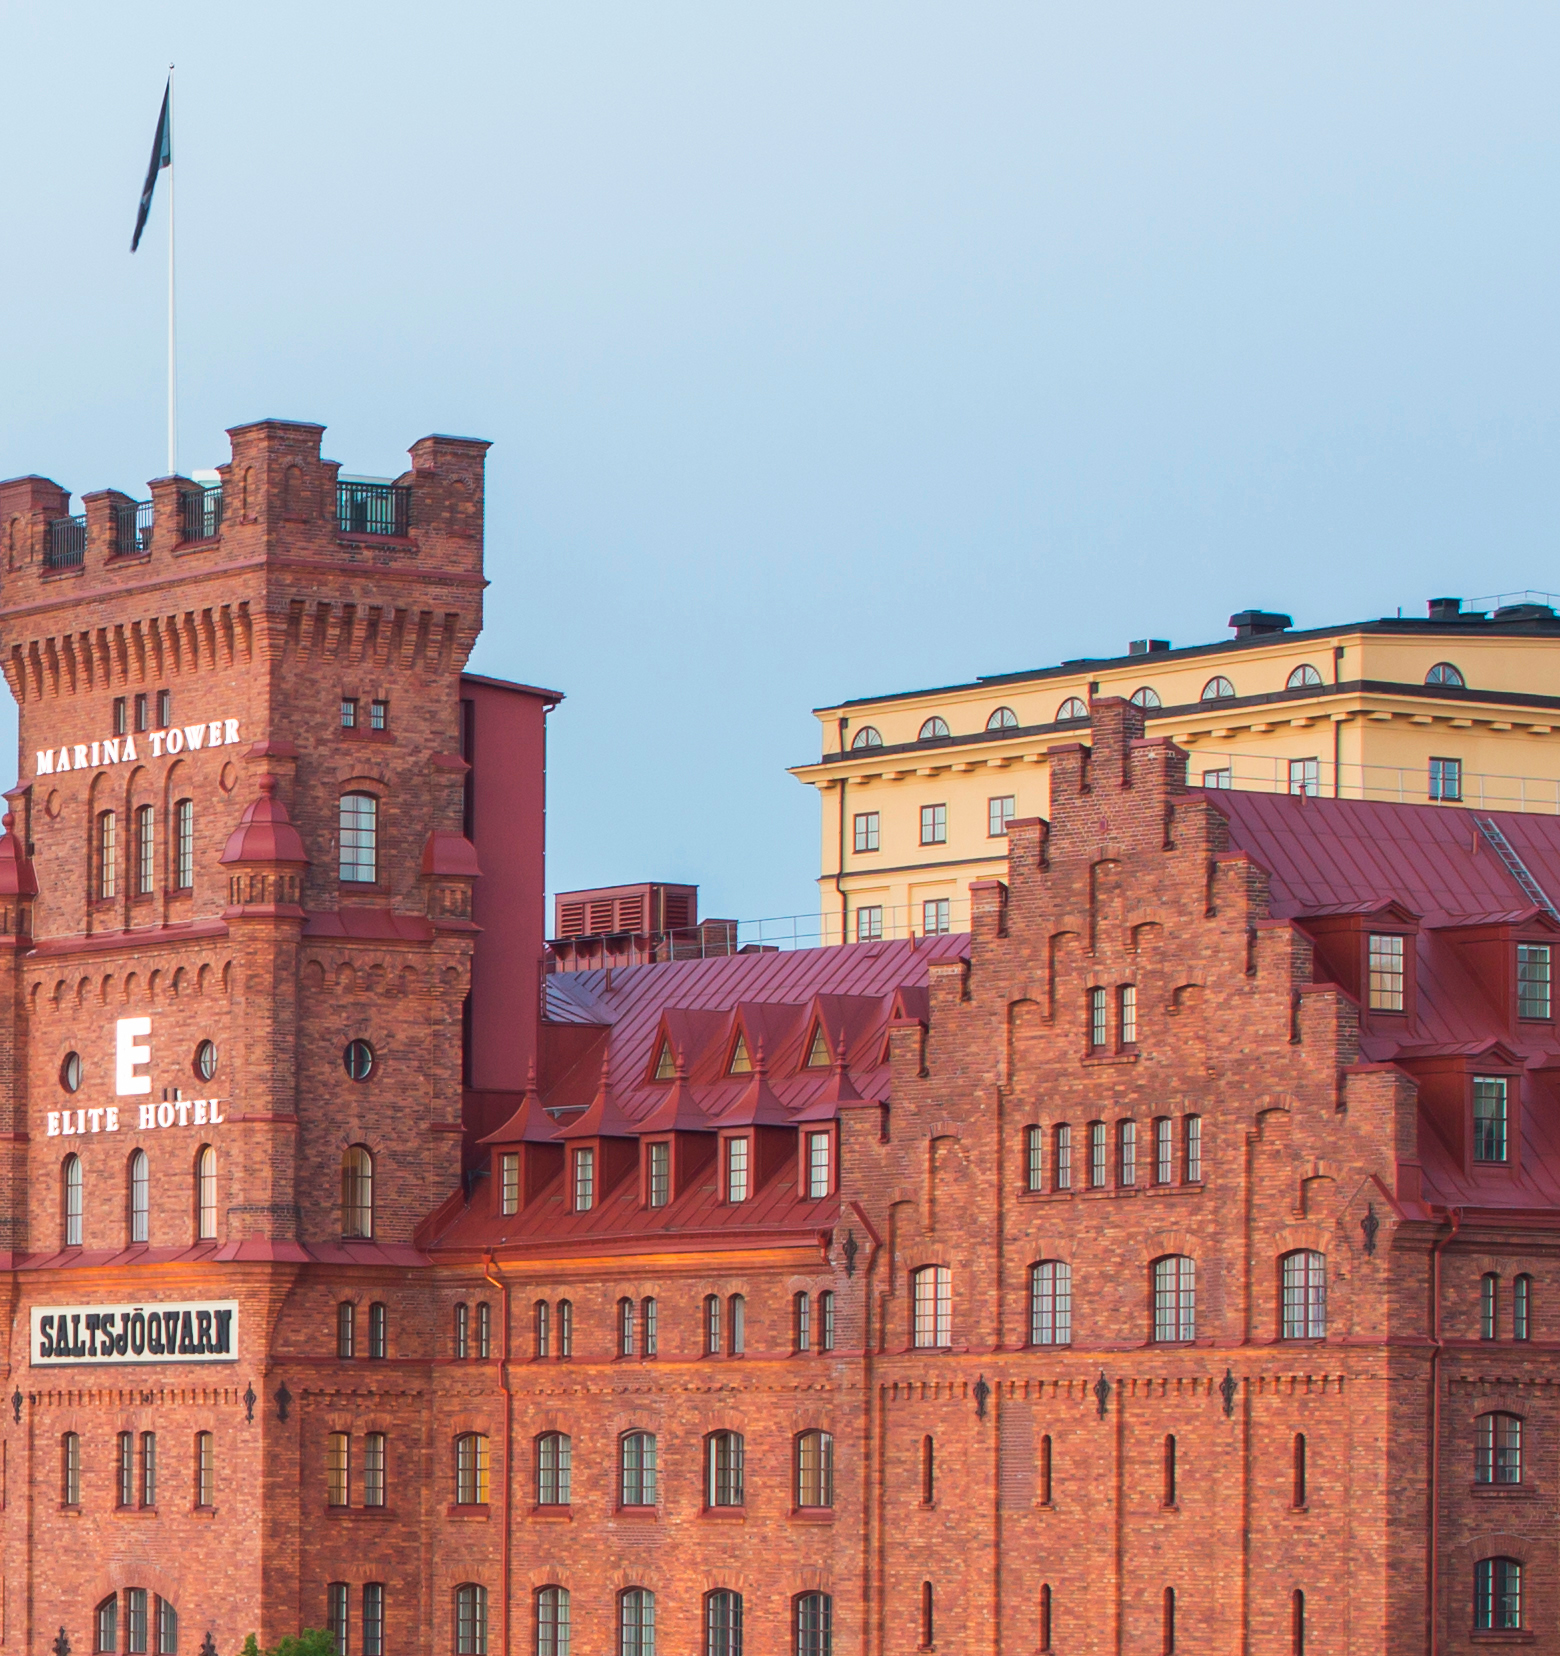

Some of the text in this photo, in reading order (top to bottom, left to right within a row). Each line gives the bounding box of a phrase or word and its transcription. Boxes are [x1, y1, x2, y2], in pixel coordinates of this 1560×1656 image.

[36, 718, 241, 776] MARINA TOWER
[116, 1017, 152, 1096] E
[47, 1098, 225, 1137] ELITE HOTEL
